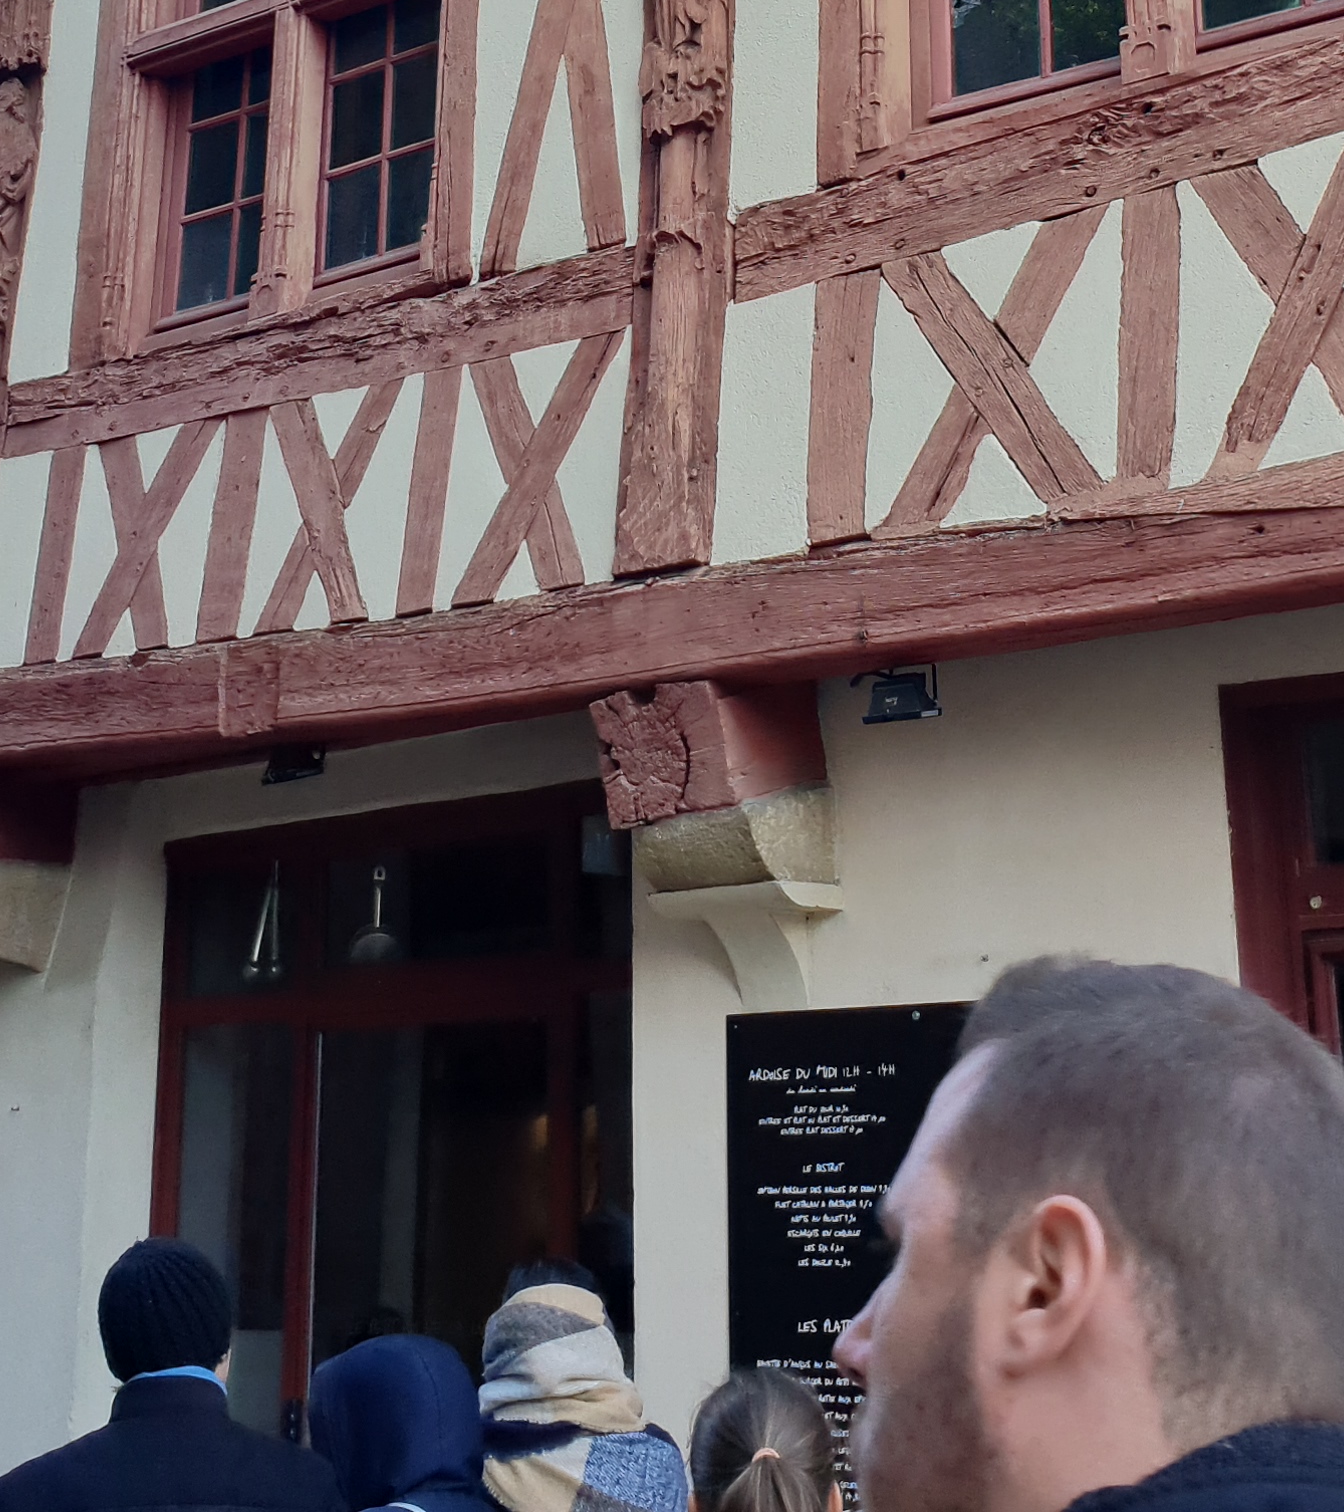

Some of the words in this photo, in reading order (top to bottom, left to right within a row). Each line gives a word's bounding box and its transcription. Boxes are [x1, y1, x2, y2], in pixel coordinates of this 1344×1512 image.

[748, 1067, 791, 1082] ARDOISE
[795, 1068, 811, 1080] DU
[816, 1064, 838, 1079] MIDI
[877, 1062, 896, 1077] 14H
[797, 1319, 818, 1333] LES
[823, 1318, 854, 1333] PLAT
